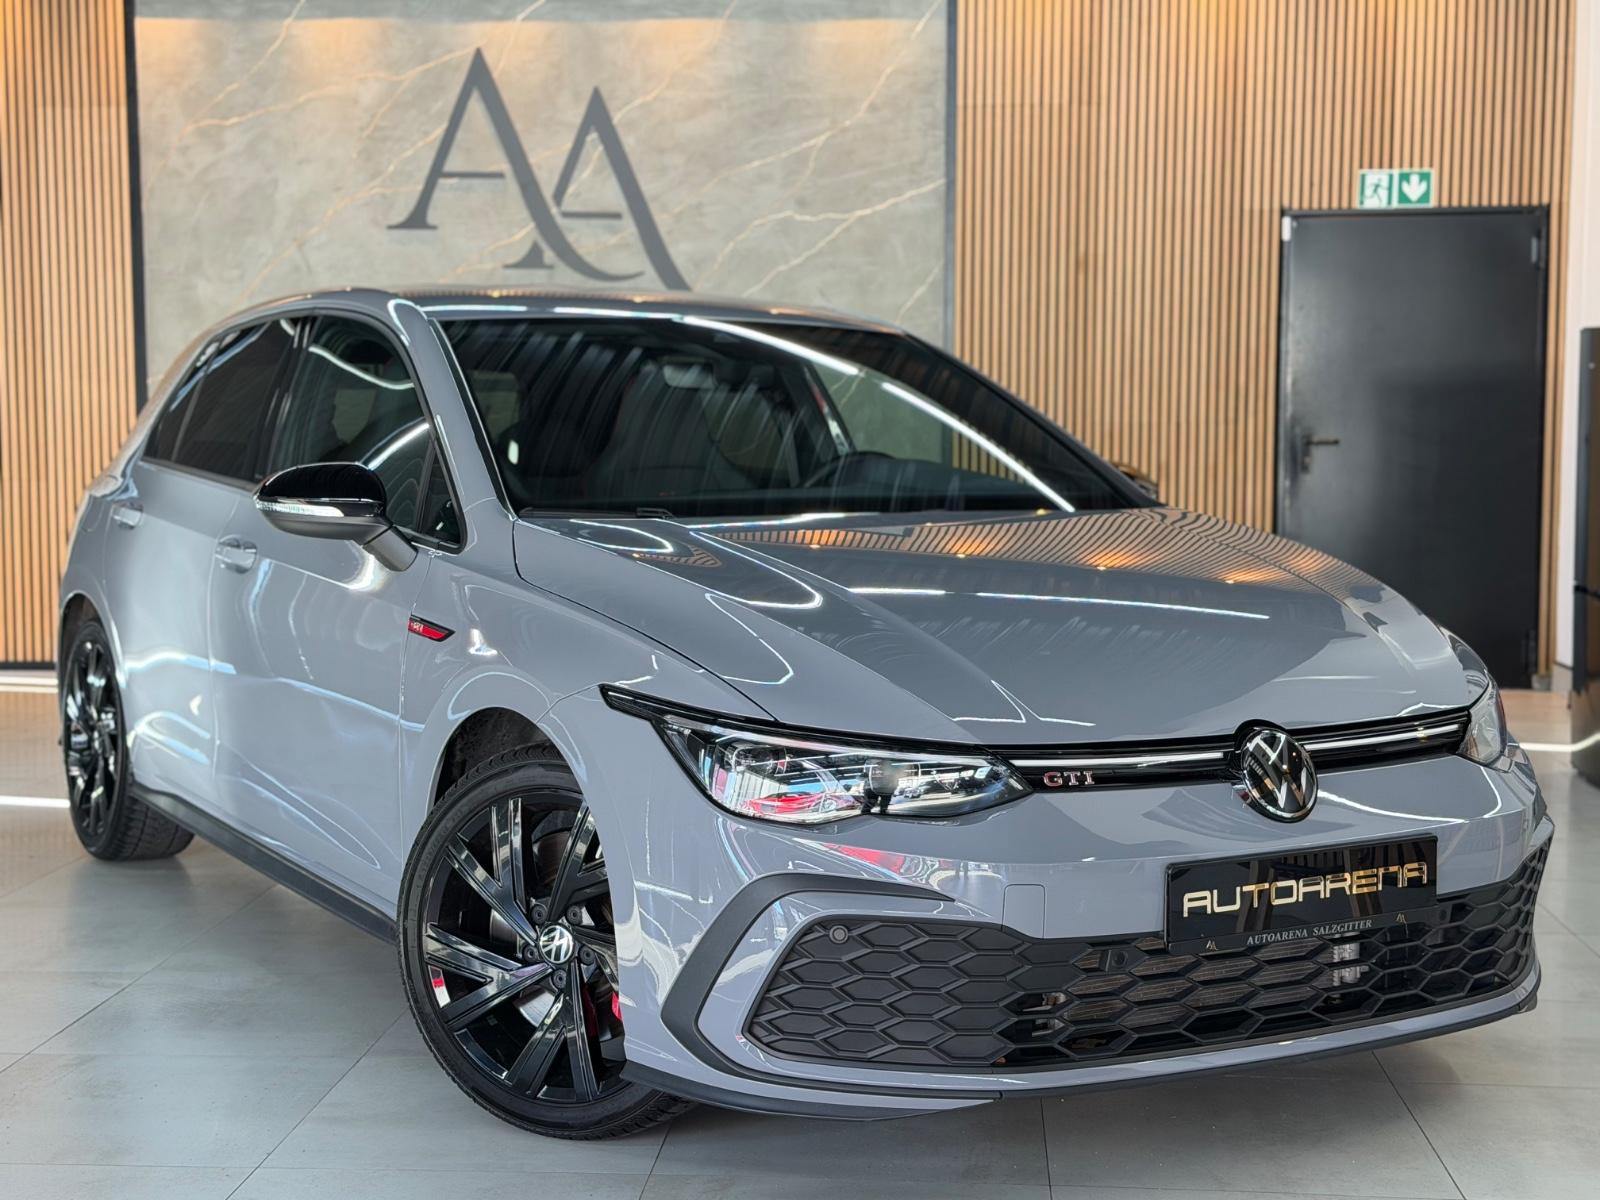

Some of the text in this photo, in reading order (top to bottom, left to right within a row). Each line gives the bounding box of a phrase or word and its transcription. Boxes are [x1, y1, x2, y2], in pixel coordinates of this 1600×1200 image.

[1043, 770, 1096, 787] GTI
[1183, 861, 1428, 918] AUTOARENA
[1246, 919, 1373, 946] AUTOARENA SALZGITTER
